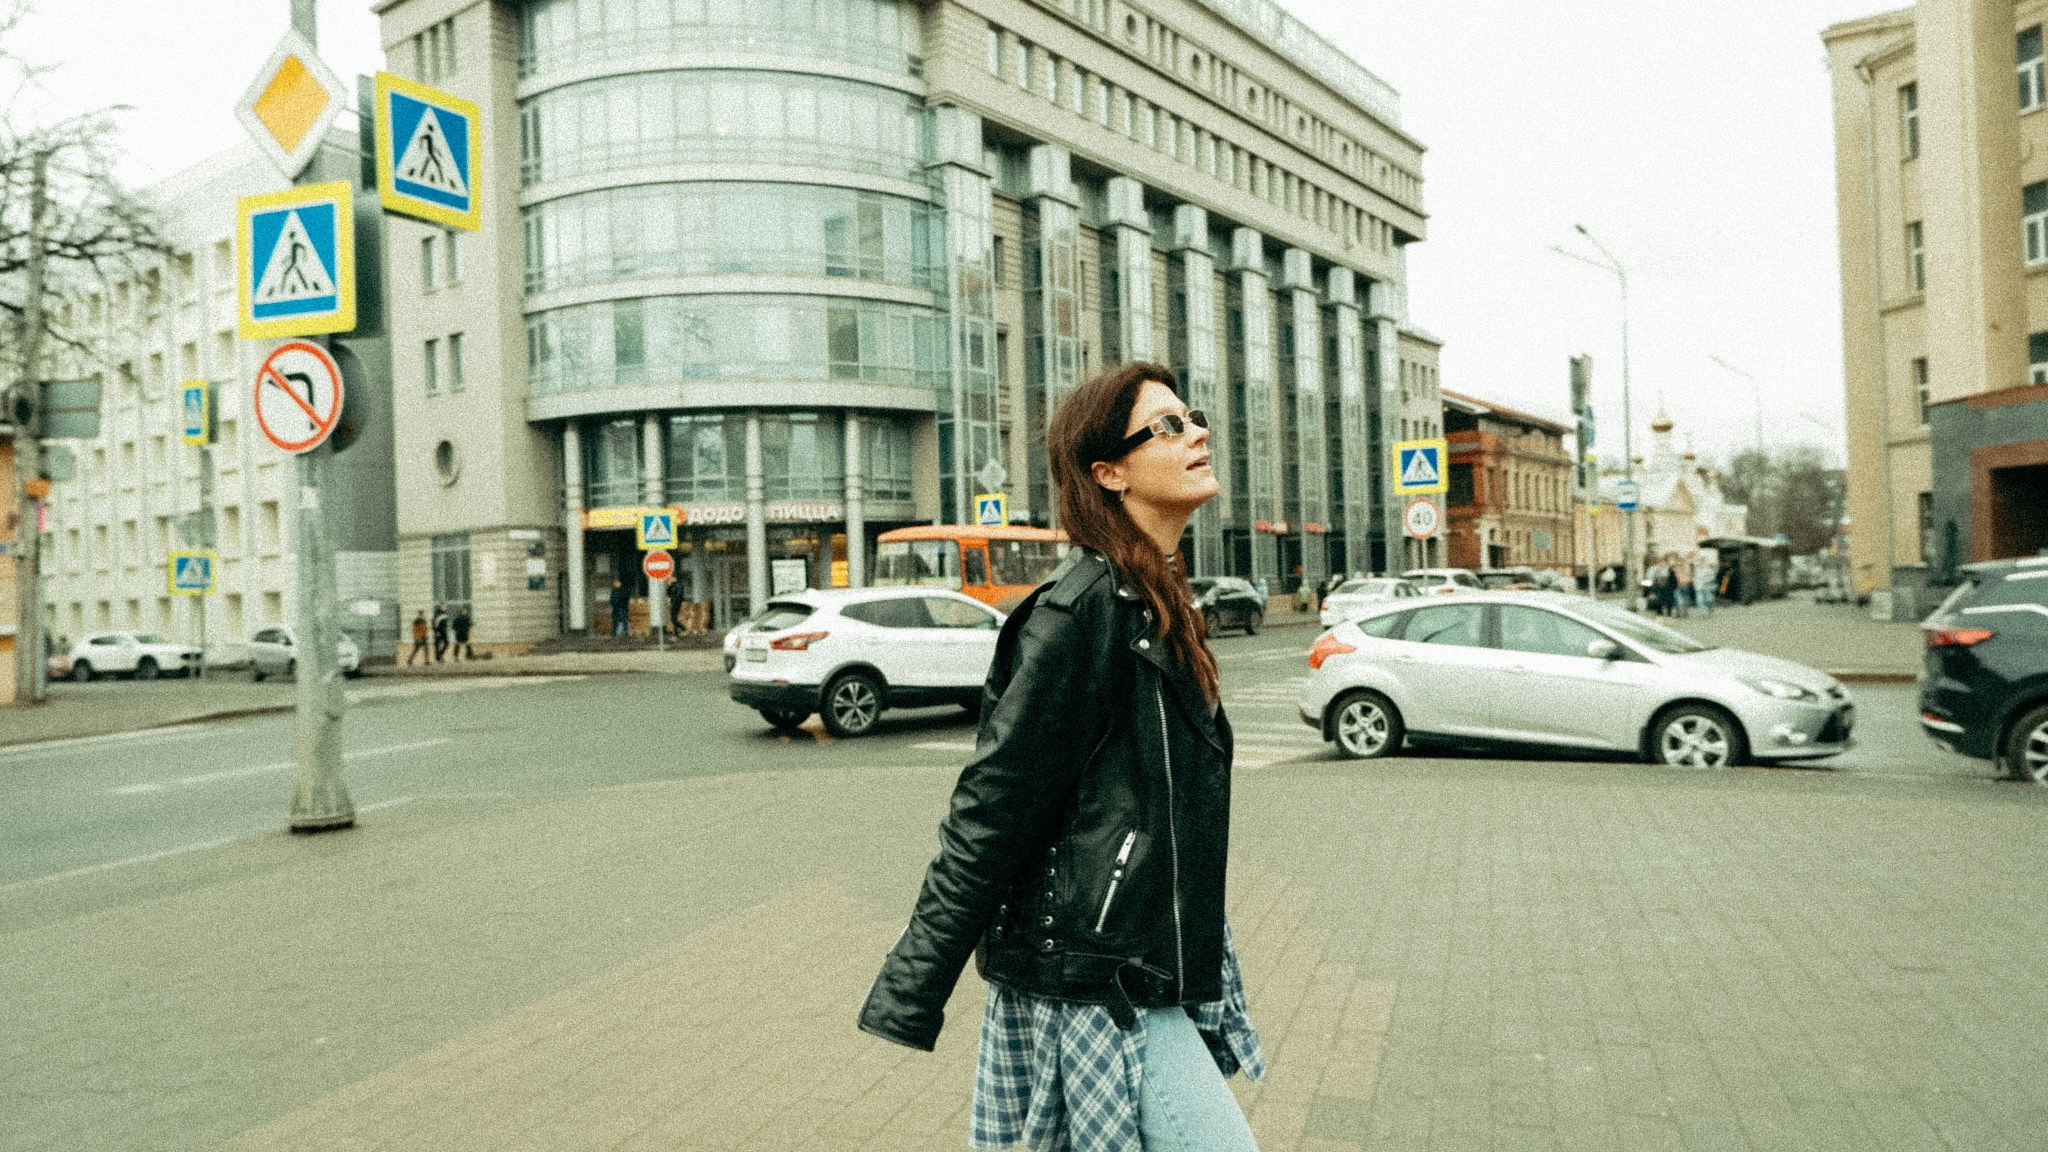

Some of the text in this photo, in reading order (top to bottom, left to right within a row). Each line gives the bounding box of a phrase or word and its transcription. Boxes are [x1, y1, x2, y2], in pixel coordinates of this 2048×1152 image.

[688, 504, 840, 524] ДОДО ПИЦЦА
[1412, 510, 1433, 526] 40
